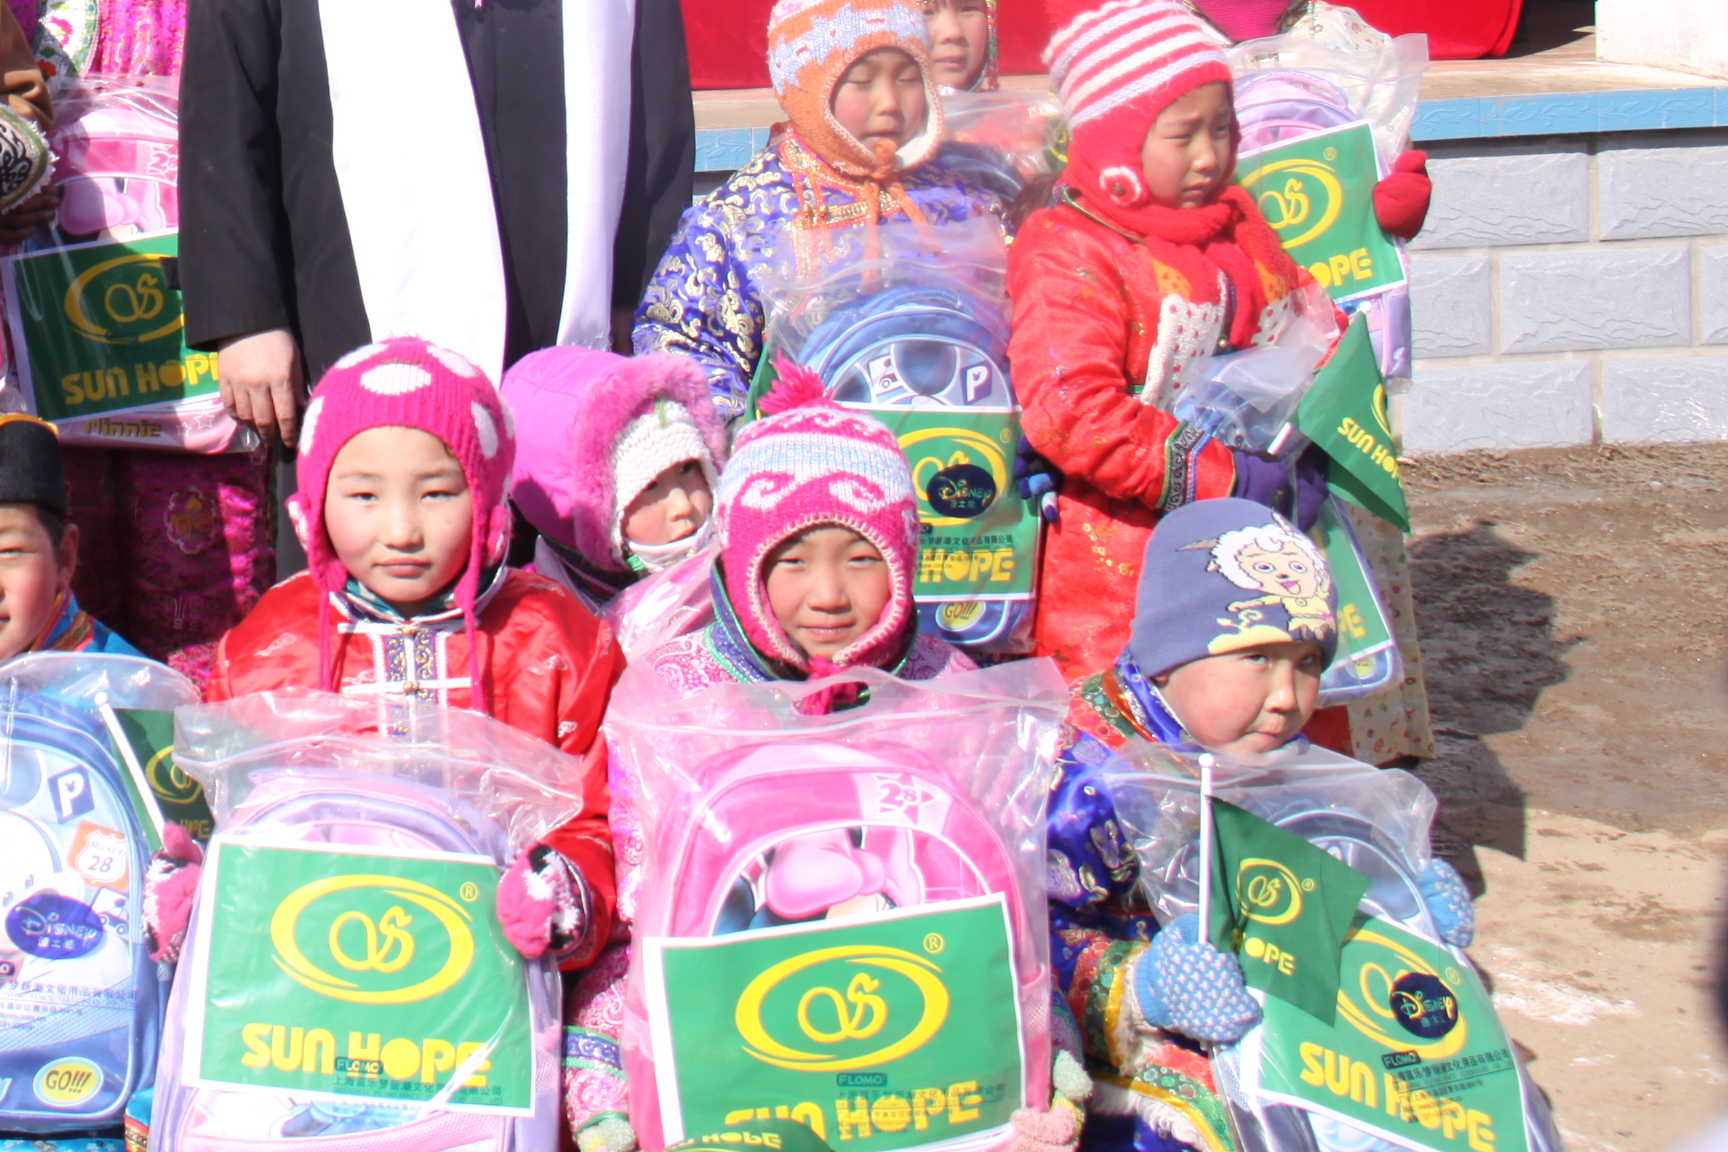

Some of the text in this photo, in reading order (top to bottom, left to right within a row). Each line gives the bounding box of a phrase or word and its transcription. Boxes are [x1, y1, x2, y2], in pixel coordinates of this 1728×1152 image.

[1298, 247, 1373, 289] OPE
[61, 365, 130, 406] SUN
[966, 365, 990, 403] P
[1336, 416, 1376, 454] SUN
[919, 548, 1015, 583] HOPE
[57, 771, 85, 818] P
[877, 784, 919, 809] 28
[87, 855, 114, 873] 28
[240, 1021, 493, 1087] SUN HOPE
[1383, 1051, 1417, 1069] FLOMO
[45, 1067, 92, 1094] GO!!!
[838, 1074, 883, 1086] FLOMO
[1299, 1041, 1378, 1109] SUN
[1383, 1072, 1498, 1151] HOPE
[835, 1080, 984, 1141] HOPE
